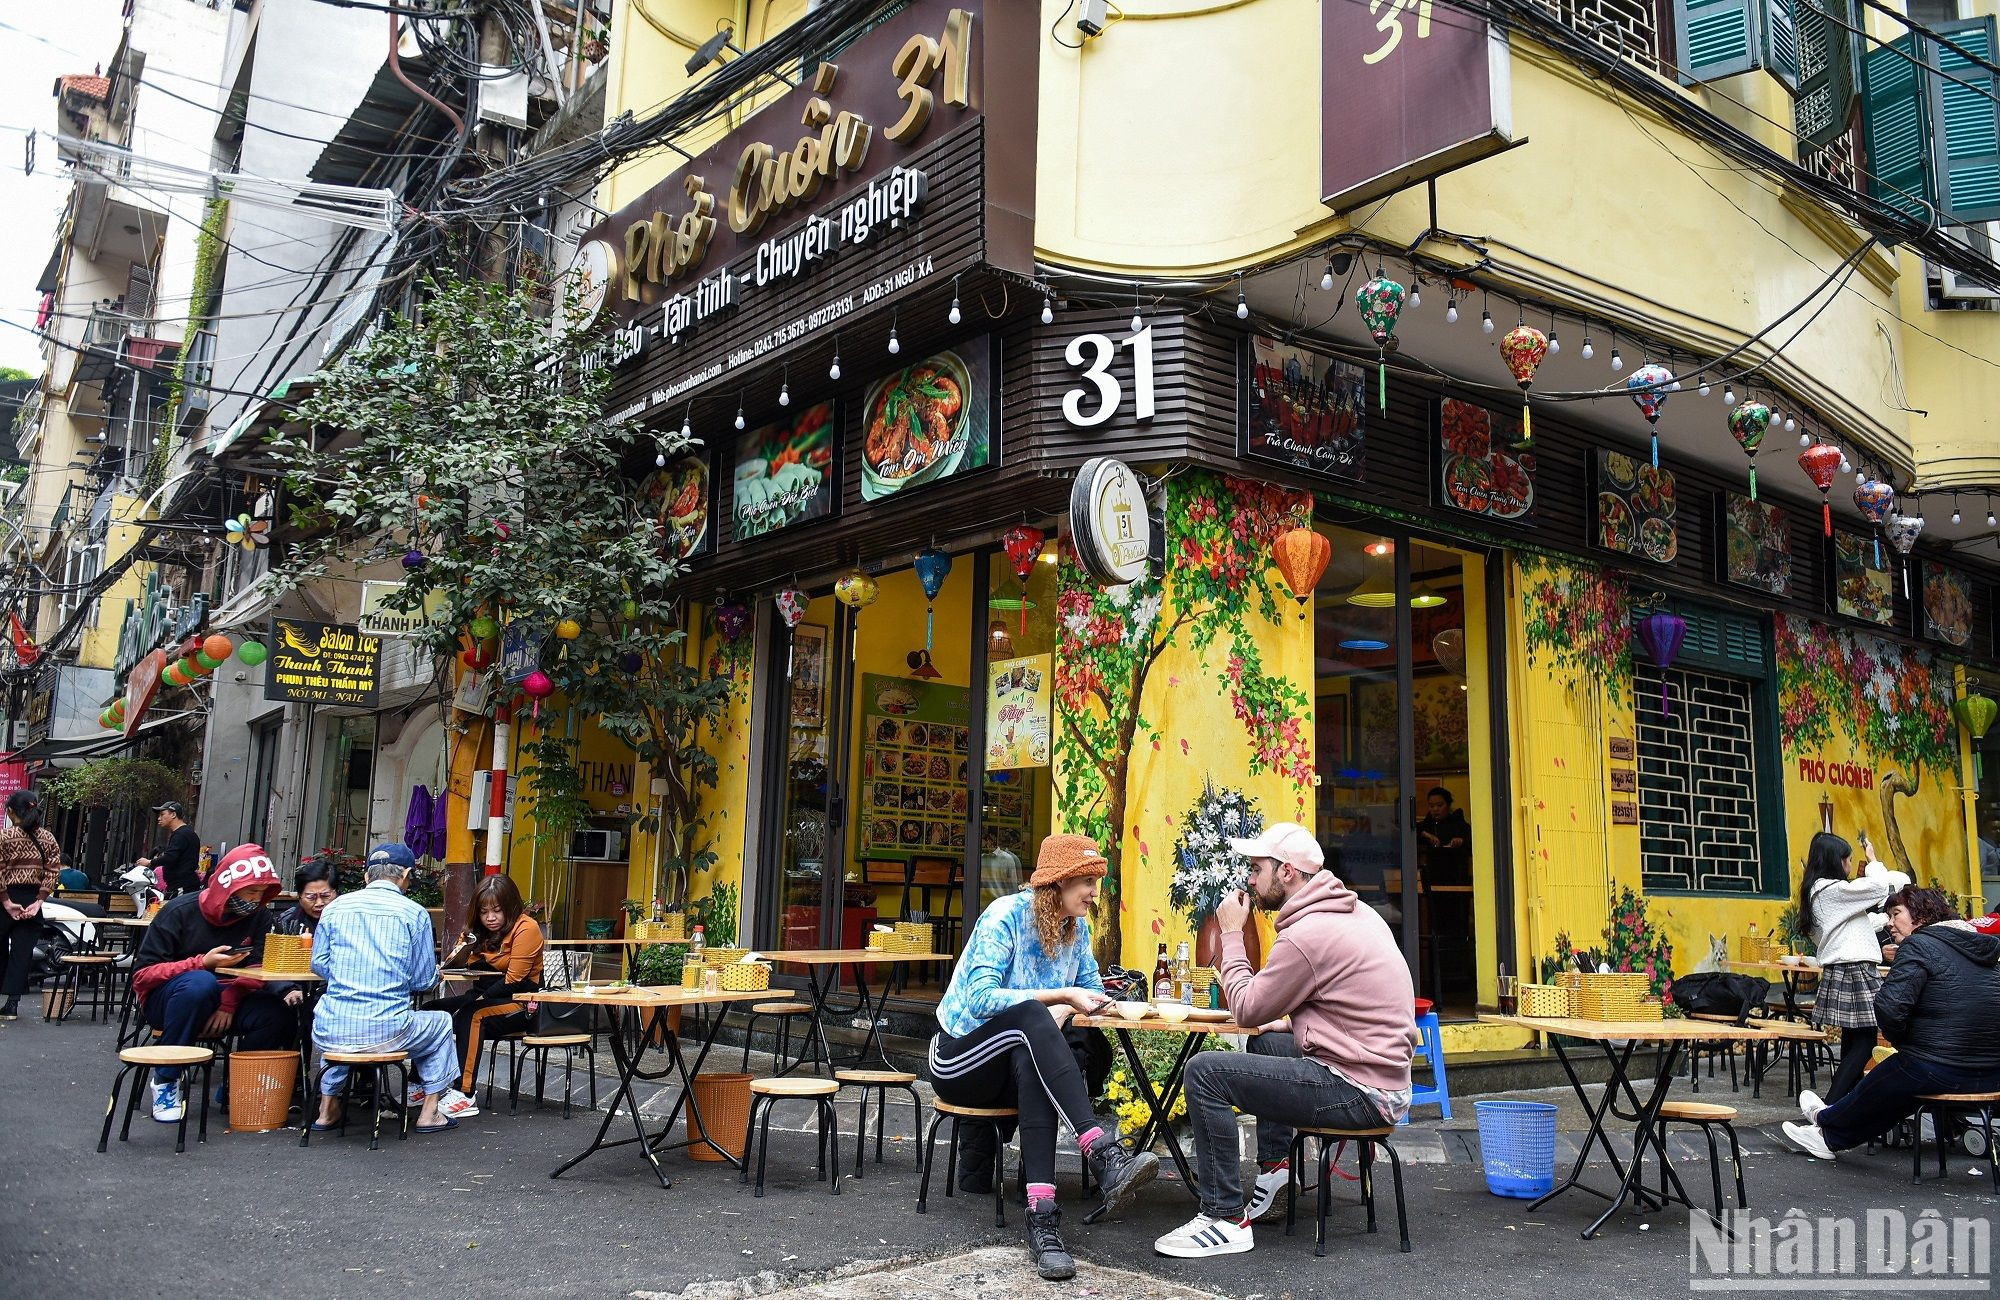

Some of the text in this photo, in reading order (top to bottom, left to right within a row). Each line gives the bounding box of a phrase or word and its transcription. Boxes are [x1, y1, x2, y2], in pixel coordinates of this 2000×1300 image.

[622, 8, 973, 301] Phở Cuốn 31
[662, 292, 691, 344] Tận
[696, 268, 732, 319] tình
[756, 213, 830, 287] Chuyên
[841, 165, 918, 244] nghiệp
[894, 265, 915, 288] NGŨ
[918, 256, 934, 279] XÃ
[1062, 324, 1155, 427] 31
[1283, 438, 1314, 455] Chanh
[319, 626, 354, 652] Salon
[273, 655, 374, 677] Thanh Thanh
[333, 652, 349, 661] 0943
[350, 653, 365, 662] 4747
[276, 673, 374, 691] PHUN THÊU THẨM MỸ
[336, 692, 364, 703] NAIL
[1799, 752, 1826, 784] PHỞ
